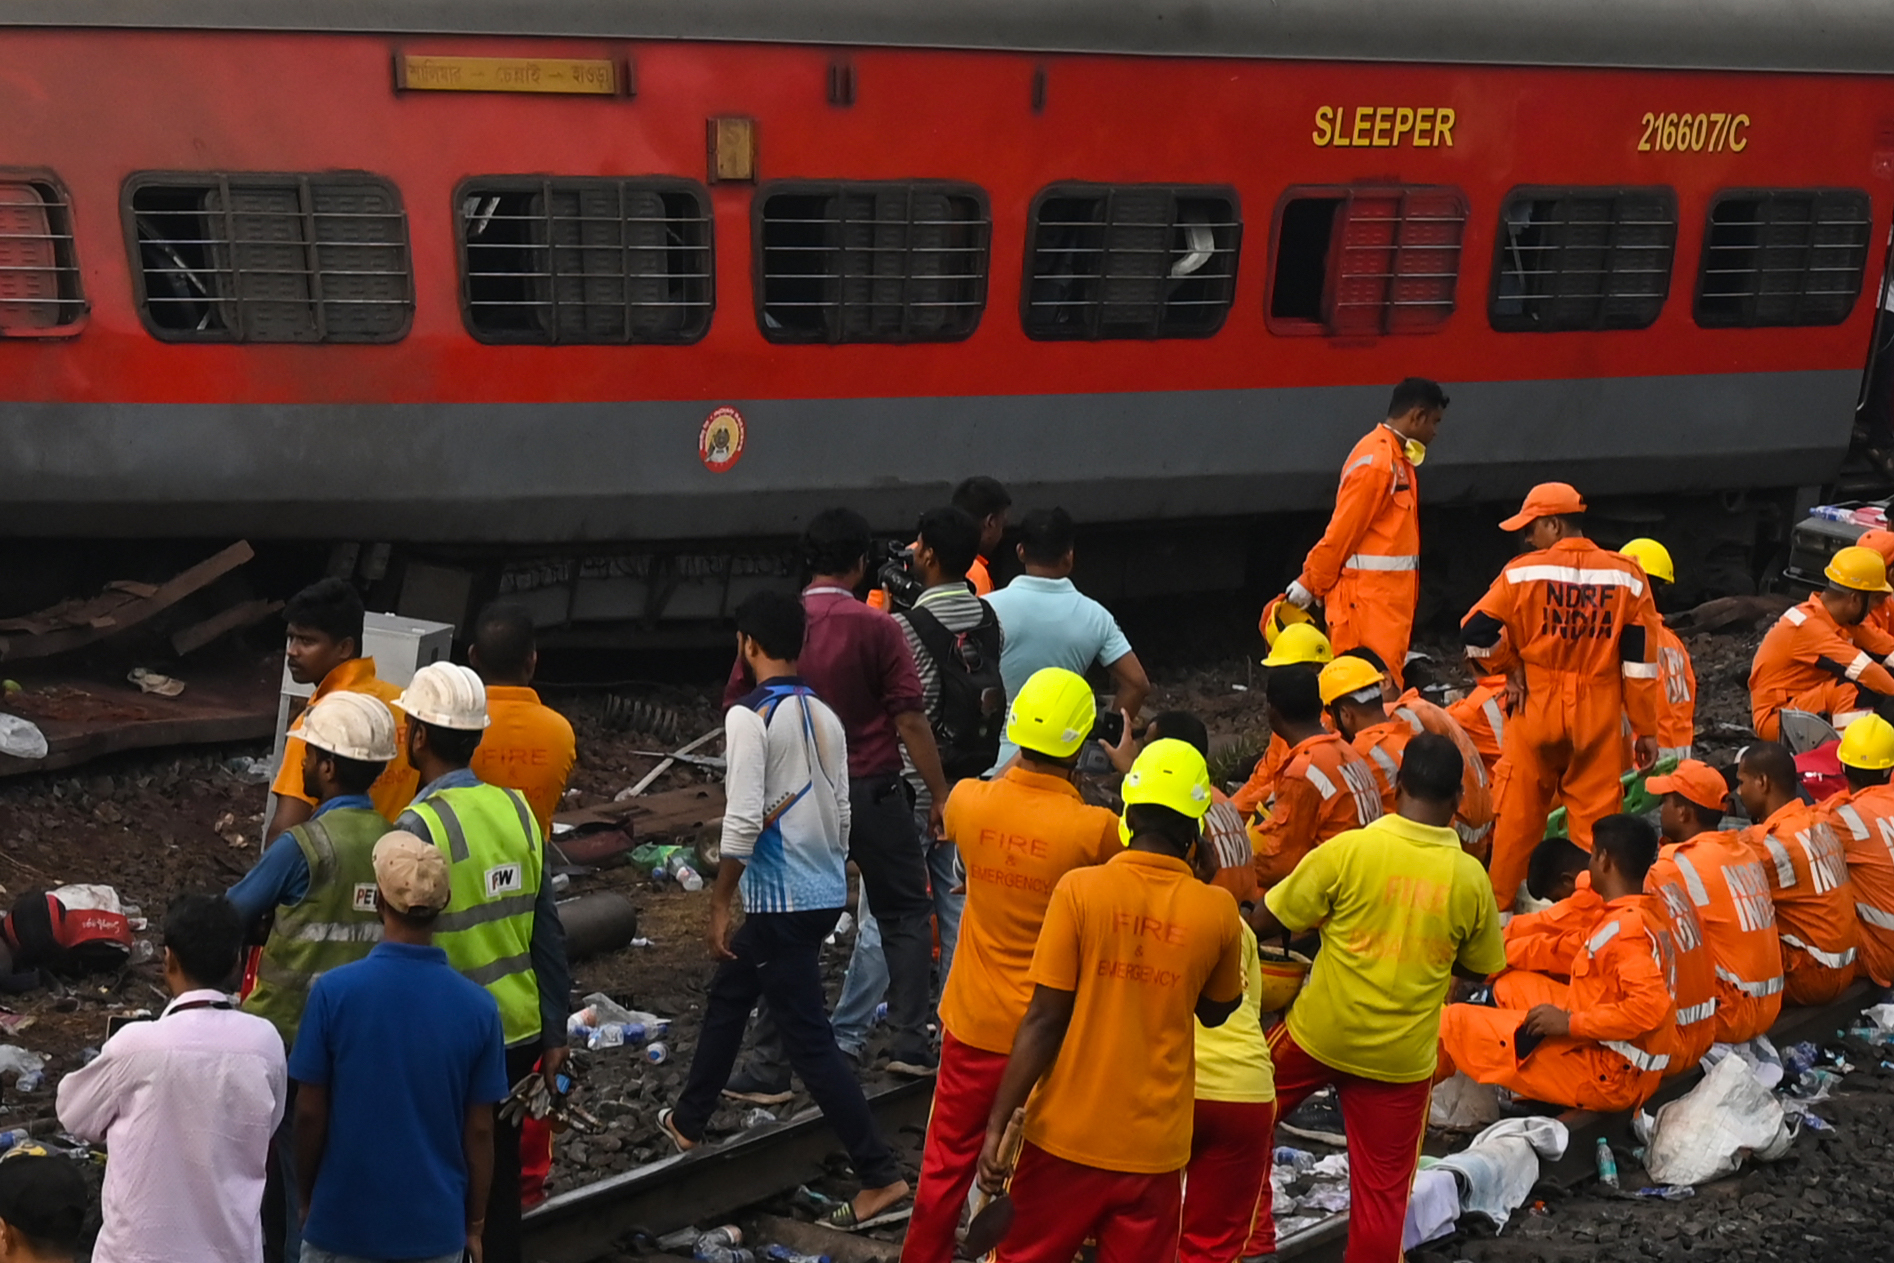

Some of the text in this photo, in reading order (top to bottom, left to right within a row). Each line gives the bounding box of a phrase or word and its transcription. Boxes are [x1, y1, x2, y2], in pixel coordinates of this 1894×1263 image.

[1312, 105, 1456, 147] SLEEPER
[1637, 112, 1750, 153] 216607/C
[1547, 582, 1616, 608] NDRF
[1542, 606, 1612, 640] INDIA
[482, 748, 549, 766] FIRE
[1337, 758, 1378, 794] ND
[1353, 788, 1385, 826] IND
[979, 828, 1049, 859] FIRE
[1005, 854, 1016, 867] &
[1214, 832, 1252, 869] IND
[970, 864, 1052, 895] EMERGENCY
[1384, 874, 1451, 915] FIRE
[1112, 912, 1187, 948] FIRE
[1733, 895, 1776, 933] IND
[1134, 944, 1144, 957] &
[1097, 959, 1181, 989] EMERGENCY
